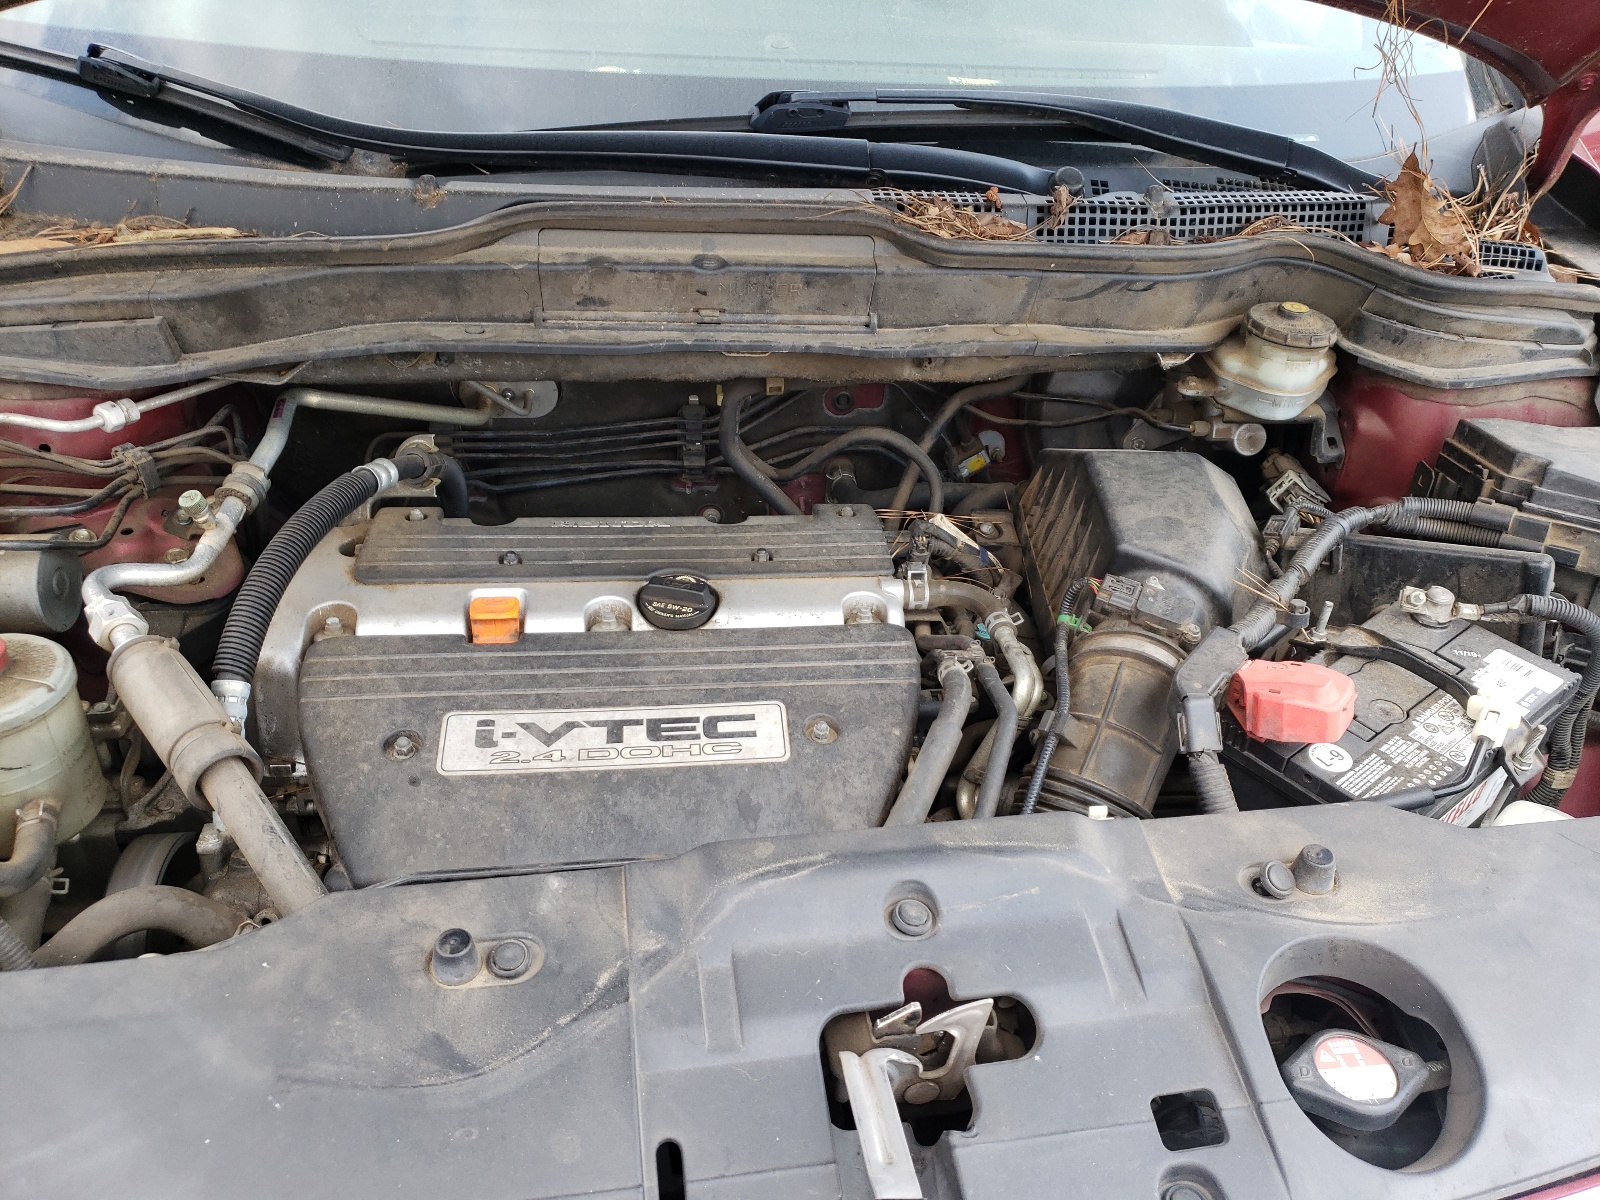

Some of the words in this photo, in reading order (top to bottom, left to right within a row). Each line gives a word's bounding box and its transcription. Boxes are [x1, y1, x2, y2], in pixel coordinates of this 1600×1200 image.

[667, 603, 693, 613] 5W-20
[474, 713, 757, 748] i-VTEC
[489, 748, 567, 764] 2.4
[578, 741, 742, 761] DOHC
[1316, 749, 1344, 767] L-9
